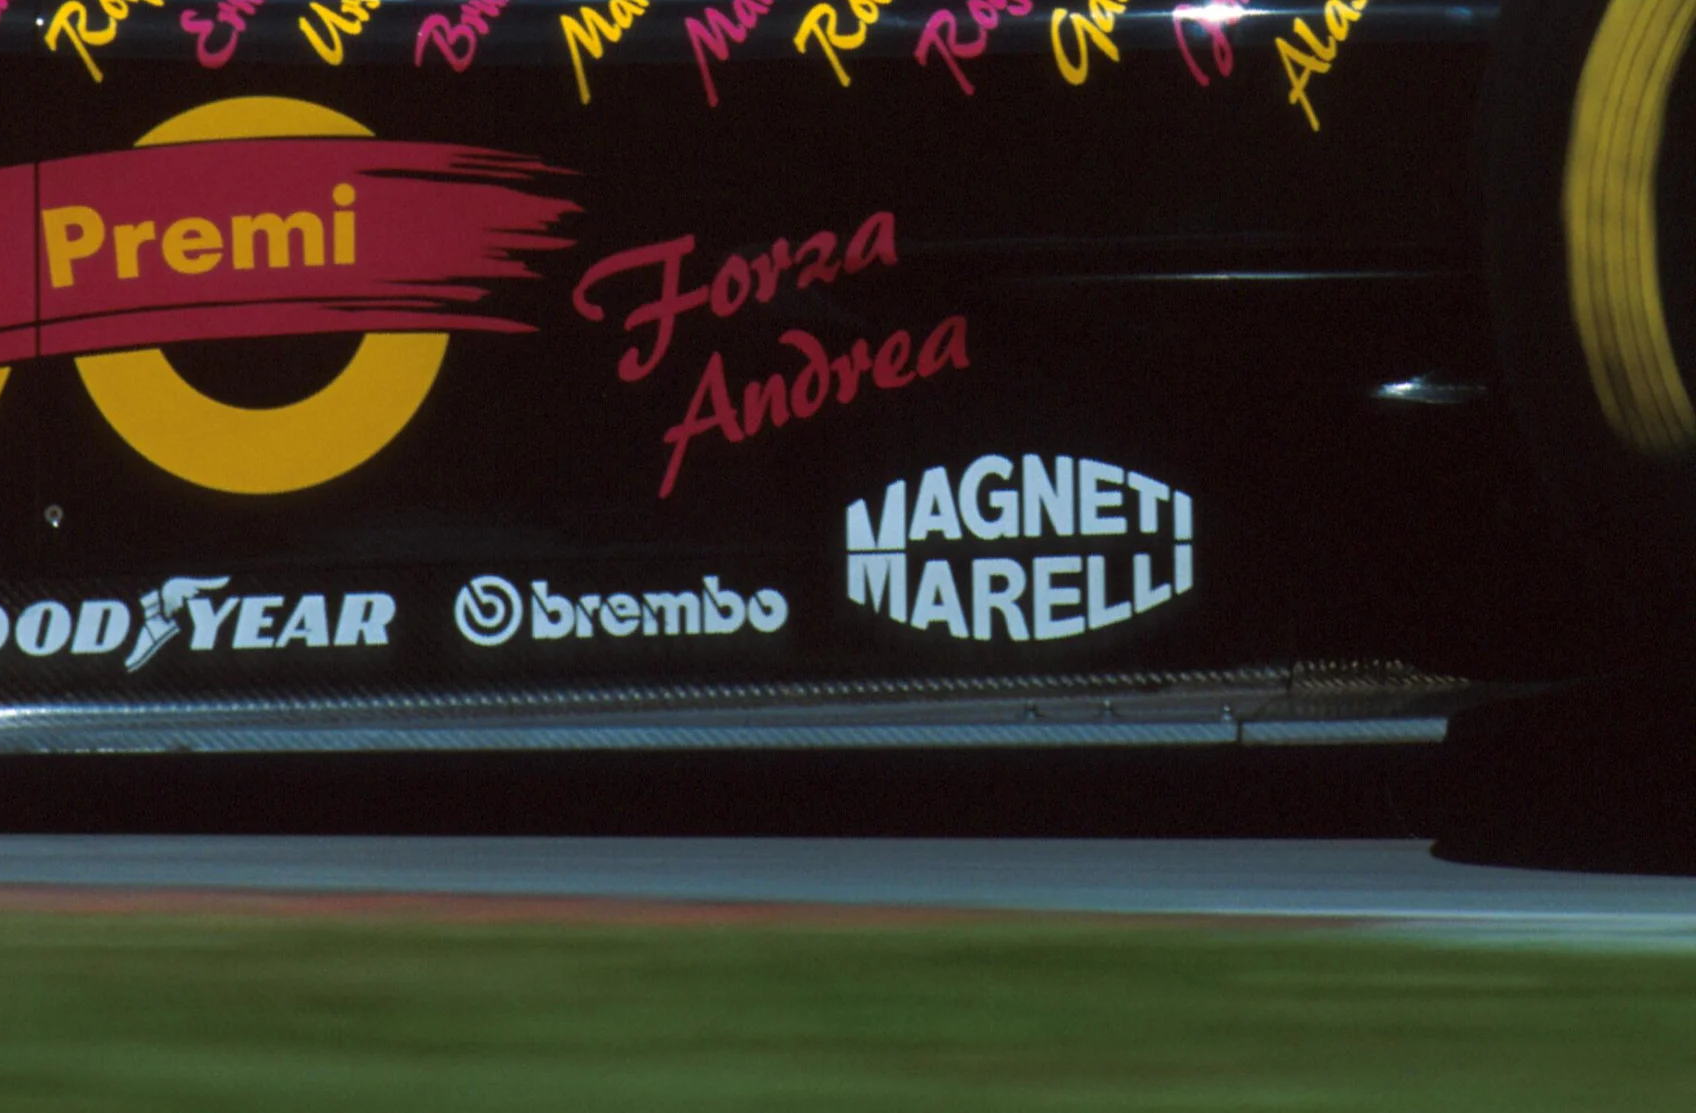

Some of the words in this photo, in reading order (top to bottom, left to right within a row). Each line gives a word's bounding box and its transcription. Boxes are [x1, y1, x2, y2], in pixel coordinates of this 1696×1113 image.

[41, 182, 357, 290] Premi
[571, 210, 899, 383] Forza
[657, 313, 972, 500] Andrea
[845, 452, 1194, 551] MAGNETI
[530, 575, 790, 641] brembo
[845, 543, 1194, 643] MARELLI
